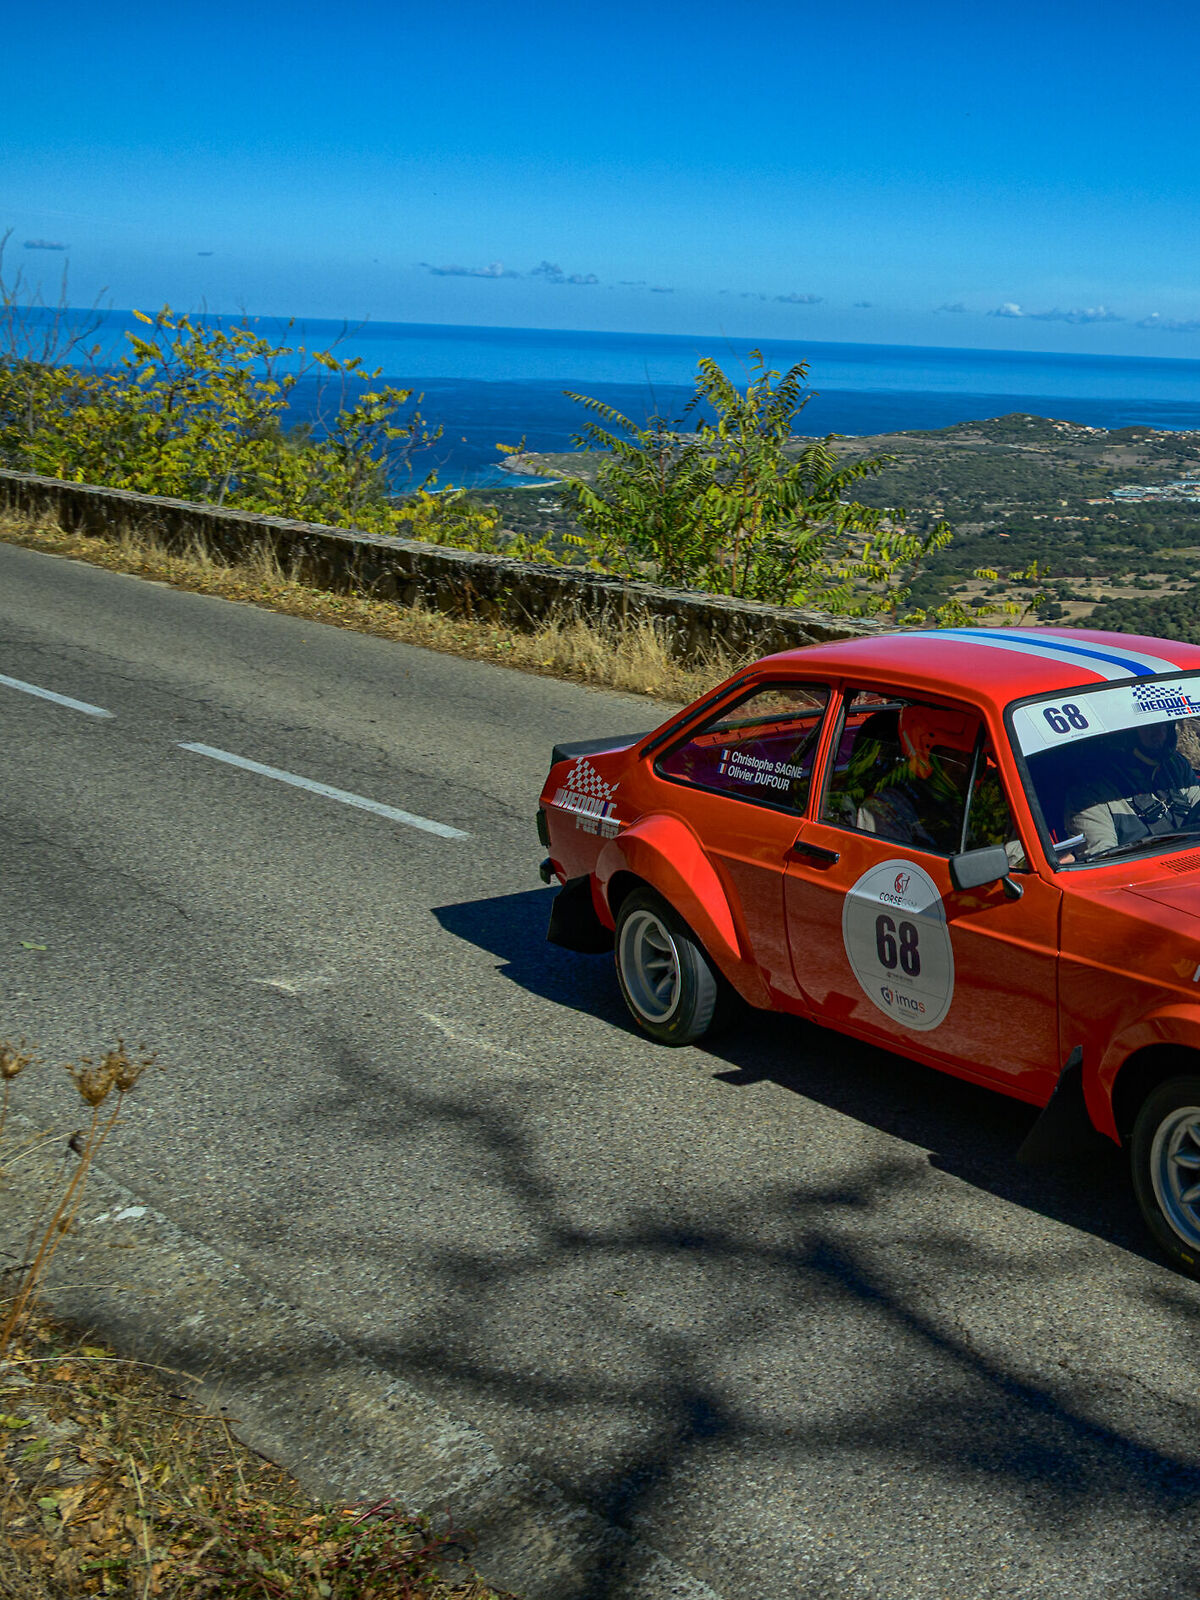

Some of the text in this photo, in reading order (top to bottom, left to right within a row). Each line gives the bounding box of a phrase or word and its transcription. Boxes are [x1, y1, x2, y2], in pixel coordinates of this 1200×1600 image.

[1043, 703, 1089, 734] 68
[727, 765, 790, 791] Olivier DUFOUR
[731, 751, 803, 779] Christophe SAGNE
[879, 892, 903, 906] CORSE
[875, 914, 921, 977] 68
[895, 990, 926, 1014] imas
